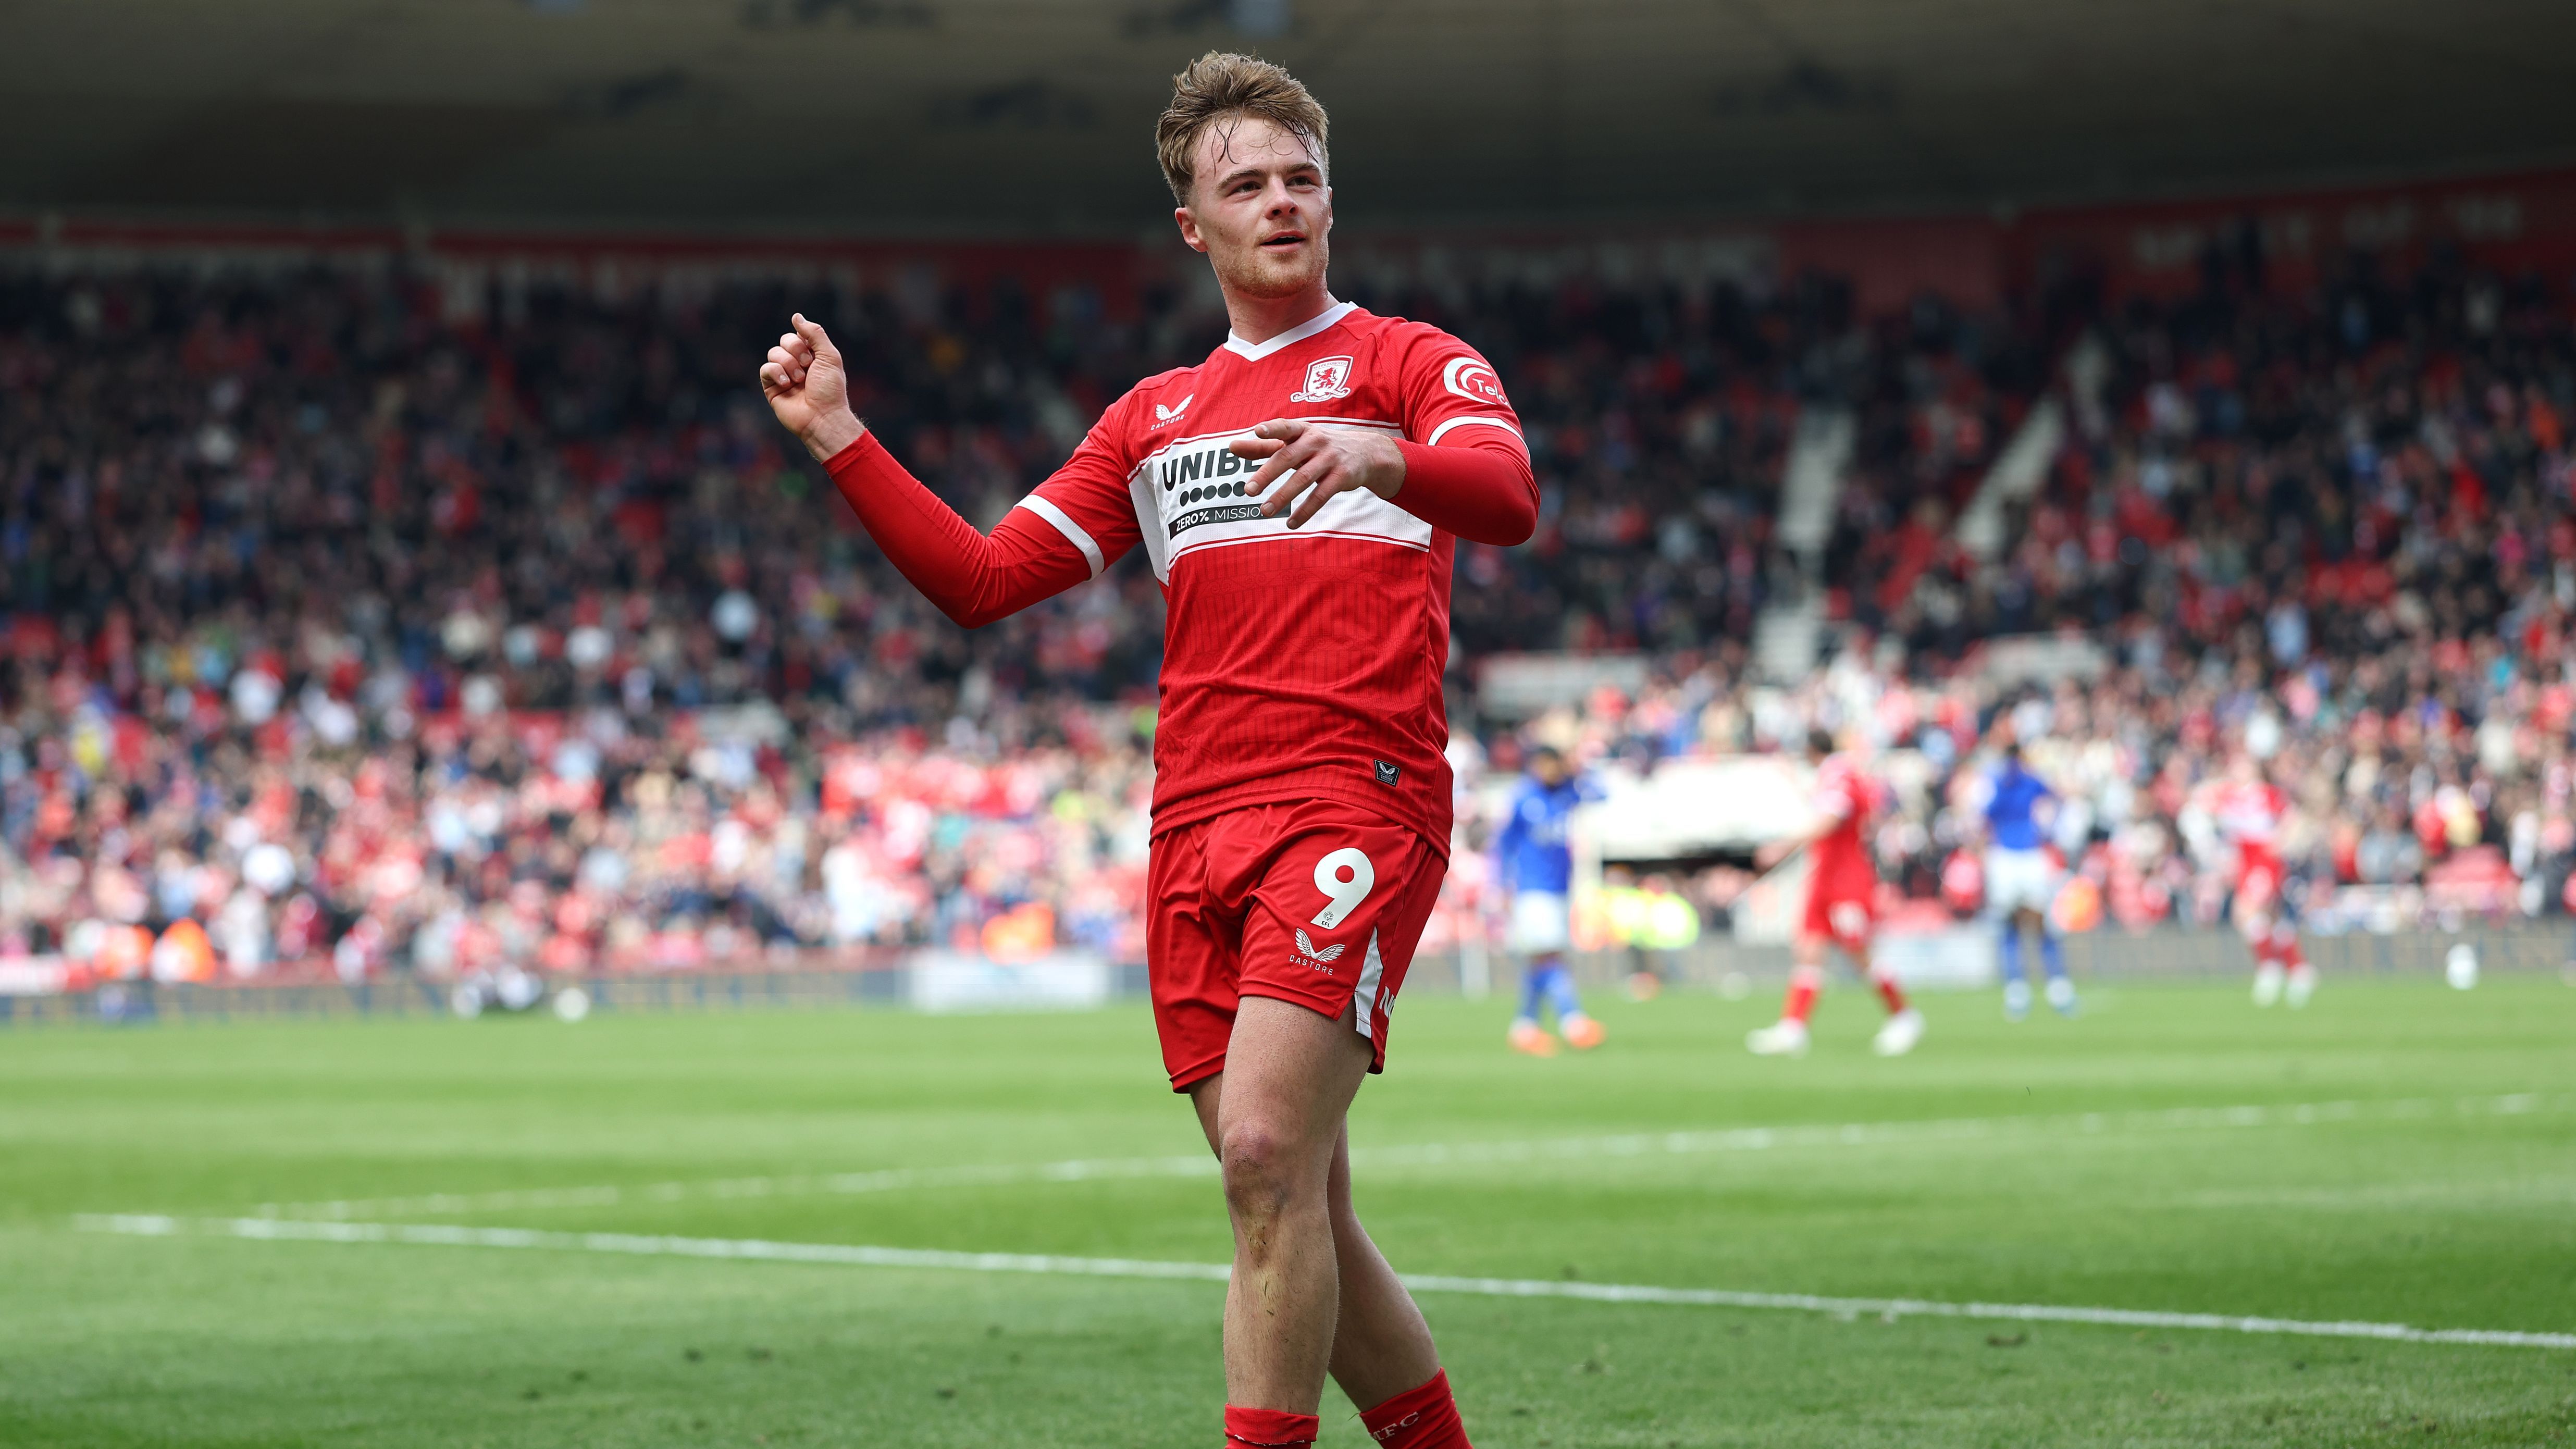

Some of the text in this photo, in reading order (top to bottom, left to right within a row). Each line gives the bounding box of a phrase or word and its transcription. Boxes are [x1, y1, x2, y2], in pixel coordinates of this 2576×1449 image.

[1150, 414, 1185, 431] CASTORE
[1162, 448, 1264, 491] UNIB
[1176, 506, 1264, 532] ZERO% MISSIO
[1310, 847, 1374, 930] 9
[1289, 955, 1334, 975] CASTORE
